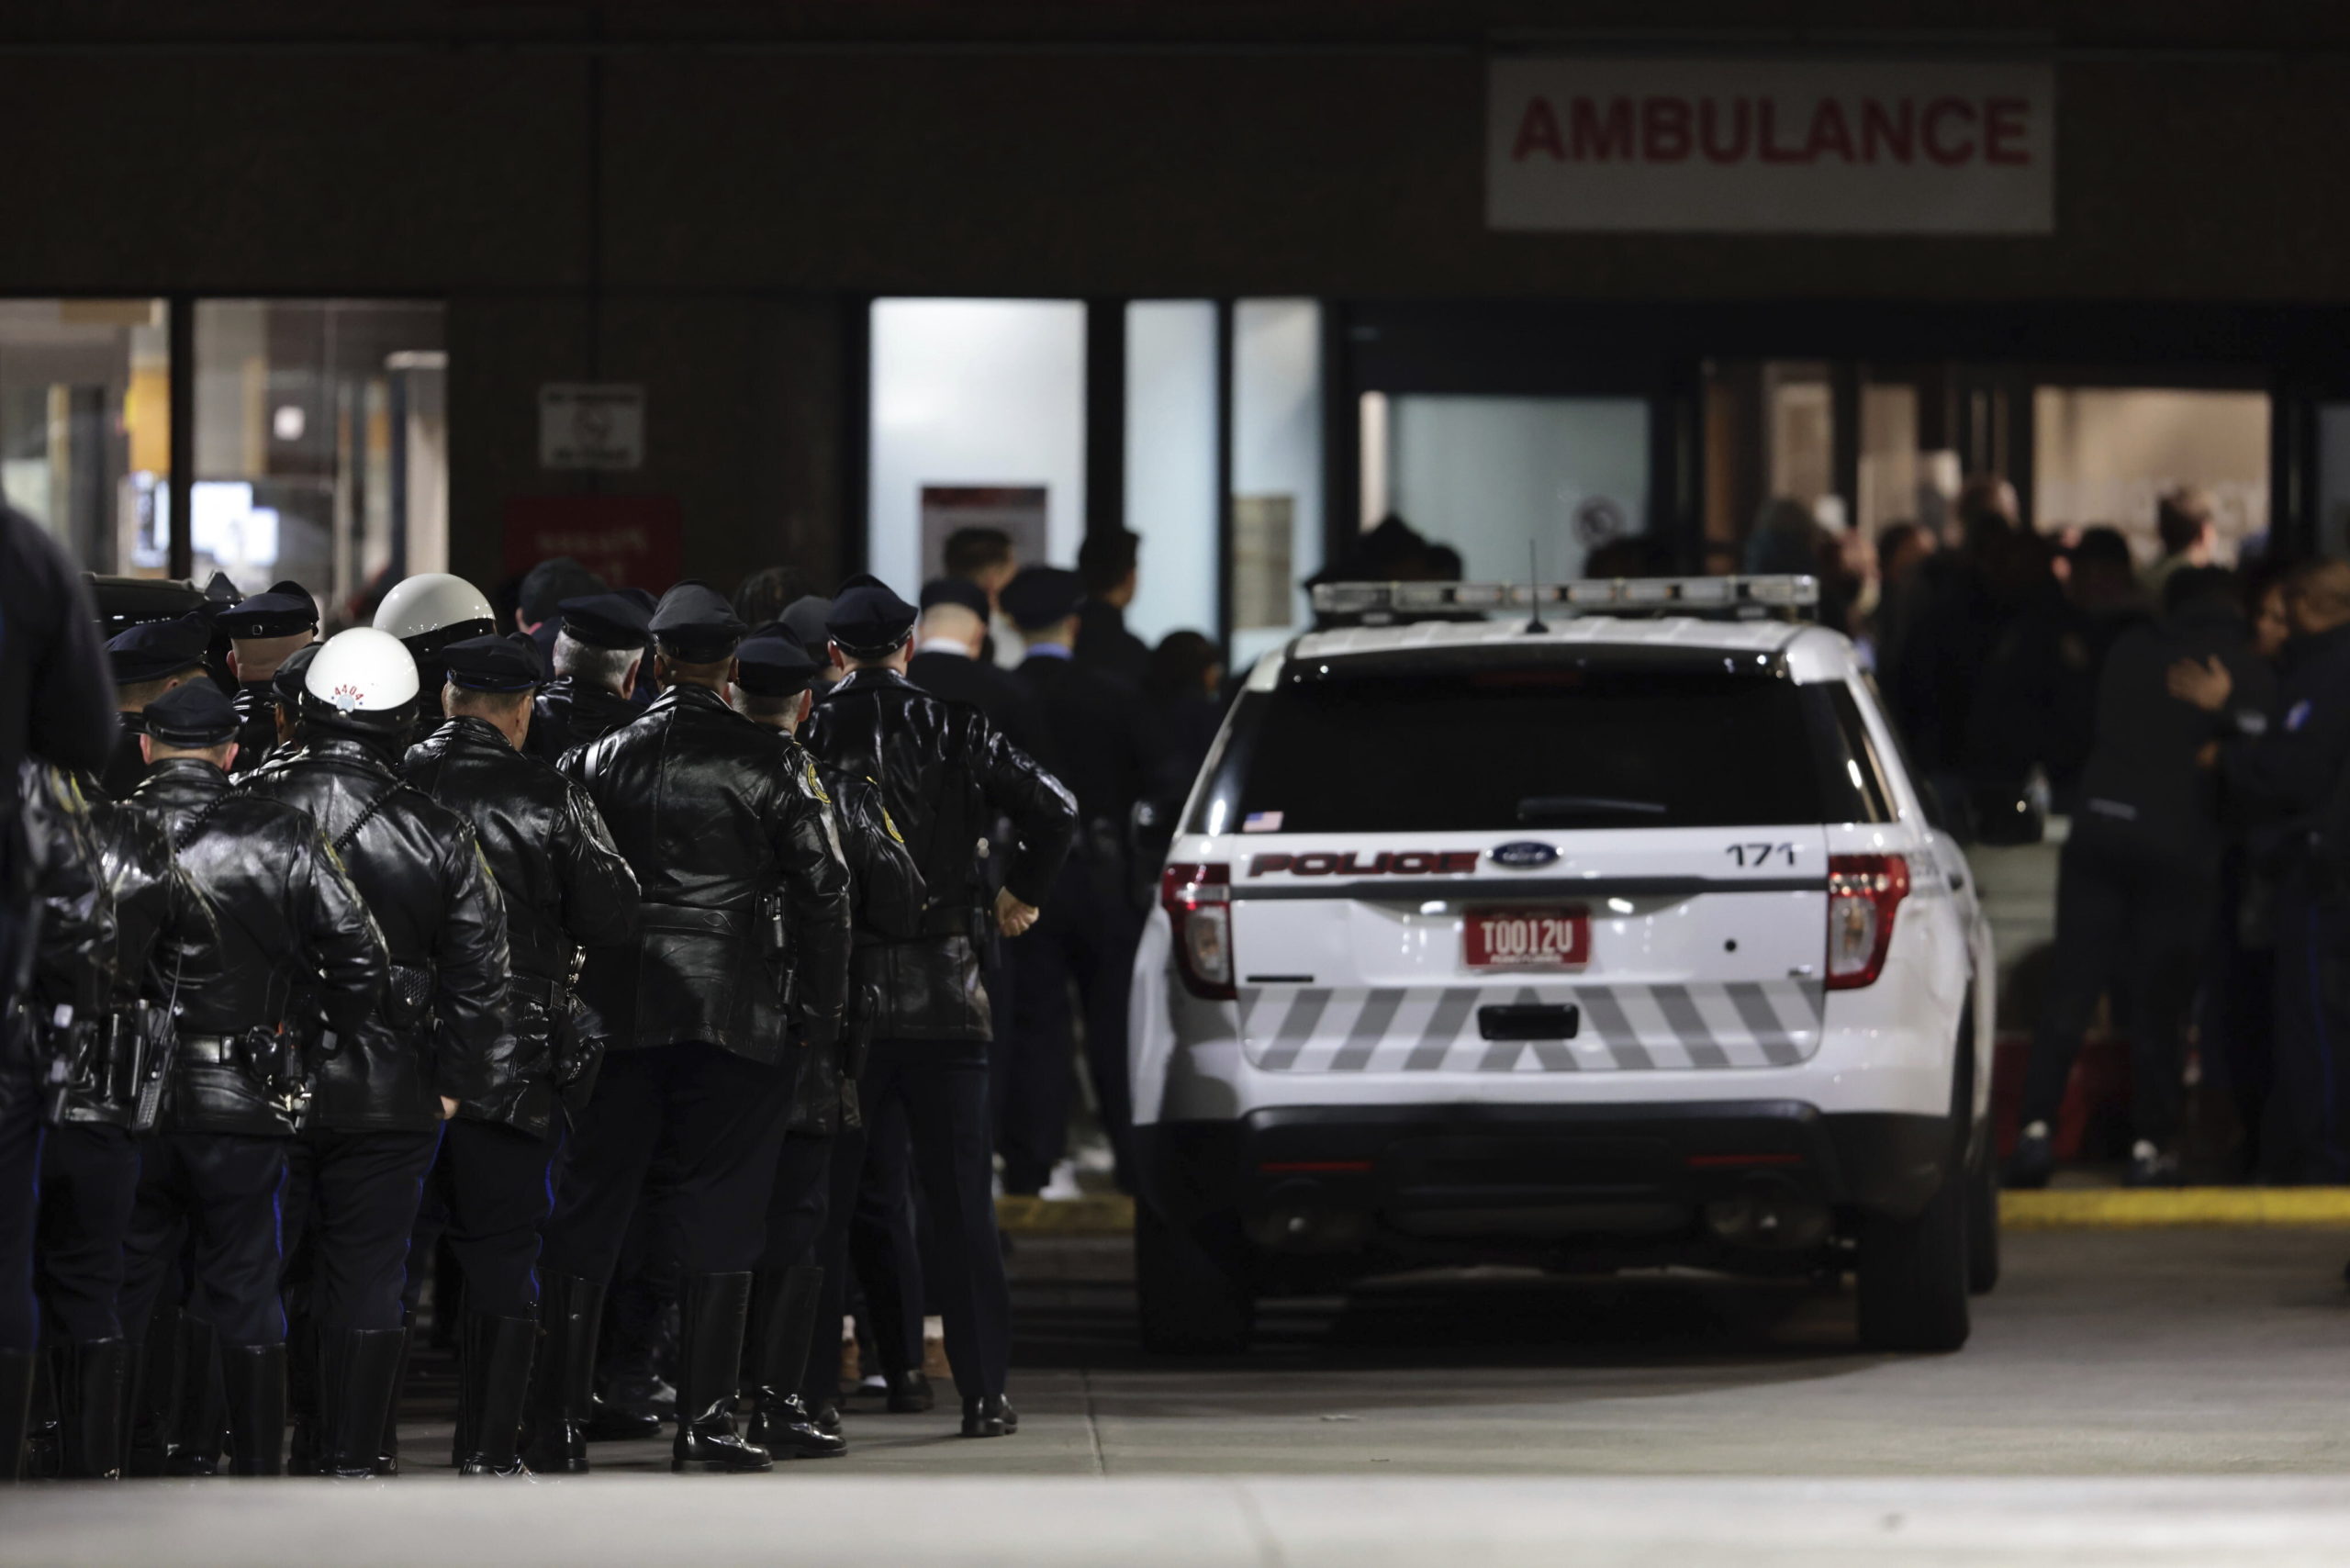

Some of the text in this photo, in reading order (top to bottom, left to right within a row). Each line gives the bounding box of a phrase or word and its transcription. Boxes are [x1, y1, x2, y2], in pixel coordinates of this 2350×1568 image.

[1513, 96, 2031, 165] AMBULANCE
[1248, 851, 1480, 877] POLICE
[1726, 843, 1795, 866] 171
